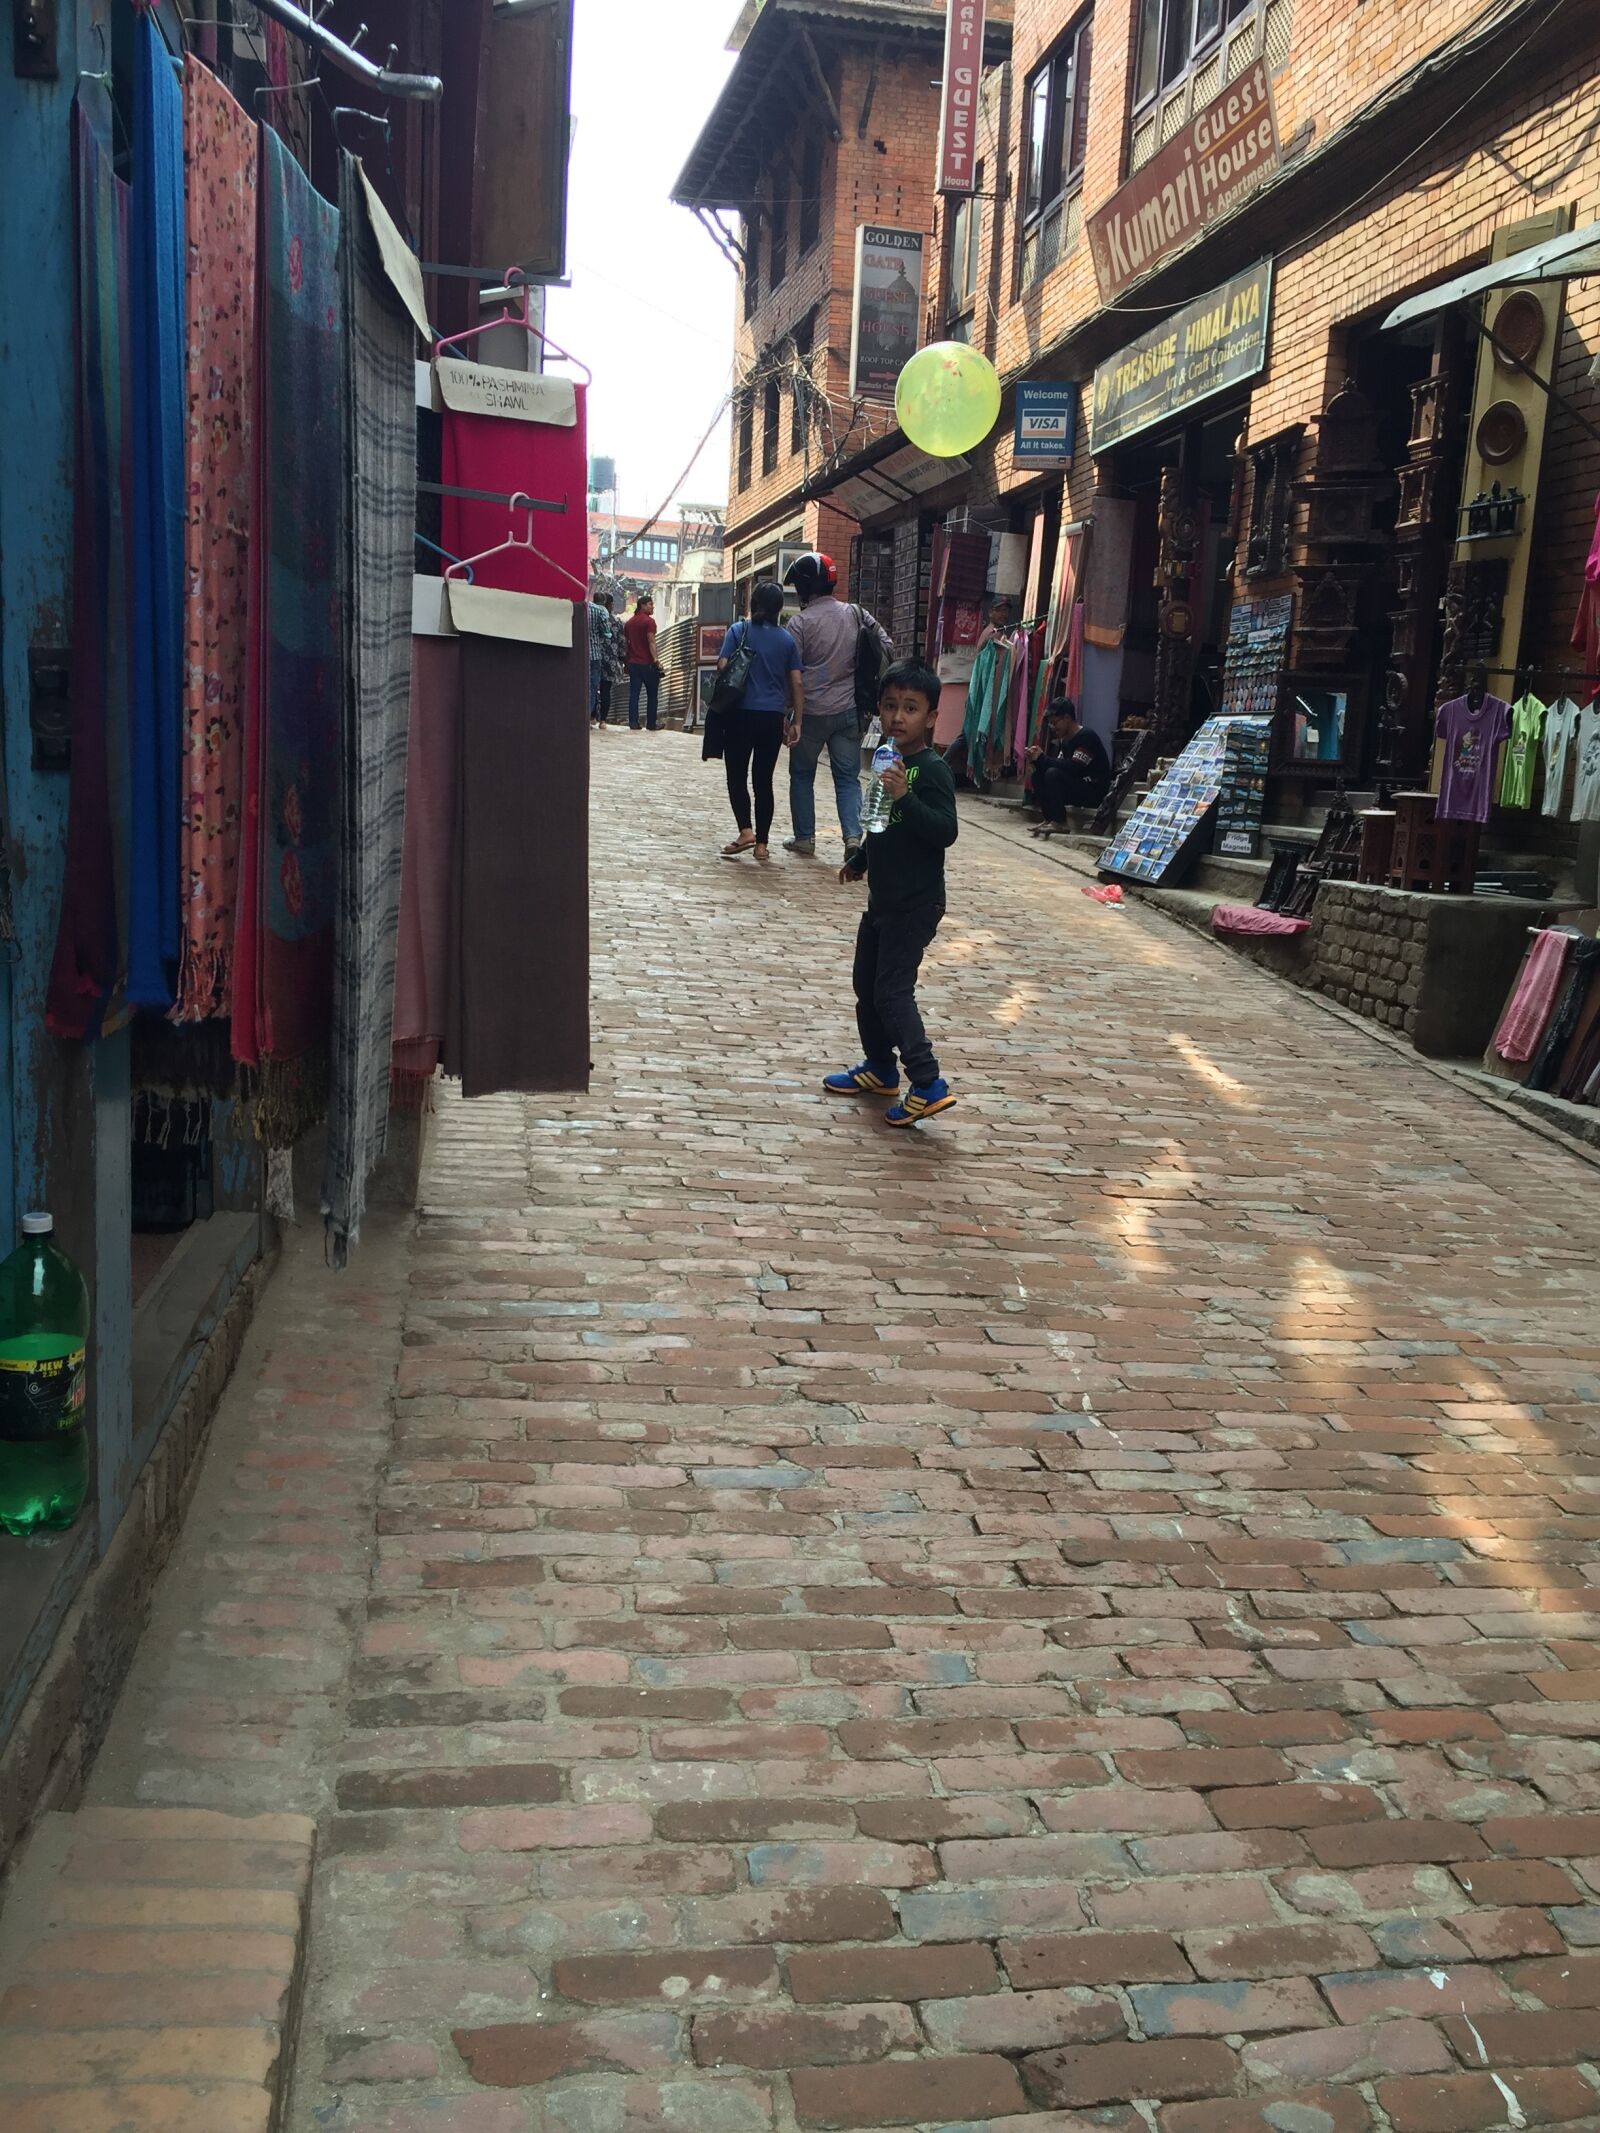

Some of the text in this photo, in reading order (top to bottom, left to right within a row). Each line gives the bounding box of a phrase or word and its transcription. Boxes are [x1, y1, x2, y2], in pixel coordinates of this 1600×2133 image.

[959, 0, 976, 50] ARI
[1193, 65, 1267, 153] Guest
[950, 67, 973, 170] GUEST
[1200, 118, 1272, 197] House
[944, 176, 970, 187] House
[1205, 152, 1279, 219] & Apartment
[1106, 146, 1201, 283] Kumari
[865, 231, 920, 249] GOLDEN
[863, 254, 903, 272] GATE
[863, 286, 909, 304] GUEST
[861, 320, 910, 337] HOUSE
[1115, 283, 1260, 398] TREASURE HIMALAYA
[880, 357, 894, 366] TOP
[1164, 330, 1260, 392] Art & Craft Collection
[485, 393, 529, 411] SHAWL
[1024, 389, 1069, 400] Welcome
[1029, 418, 1060, 429] VISA
[1020, 441, 1031, 449] All
[1041, 441, 1065, 450] takes.
[1226, 833, 1248, 842] Fridge
[1222, 842, 1251, 852] Magnets
[39, 1360, 64, 1372] NEW
